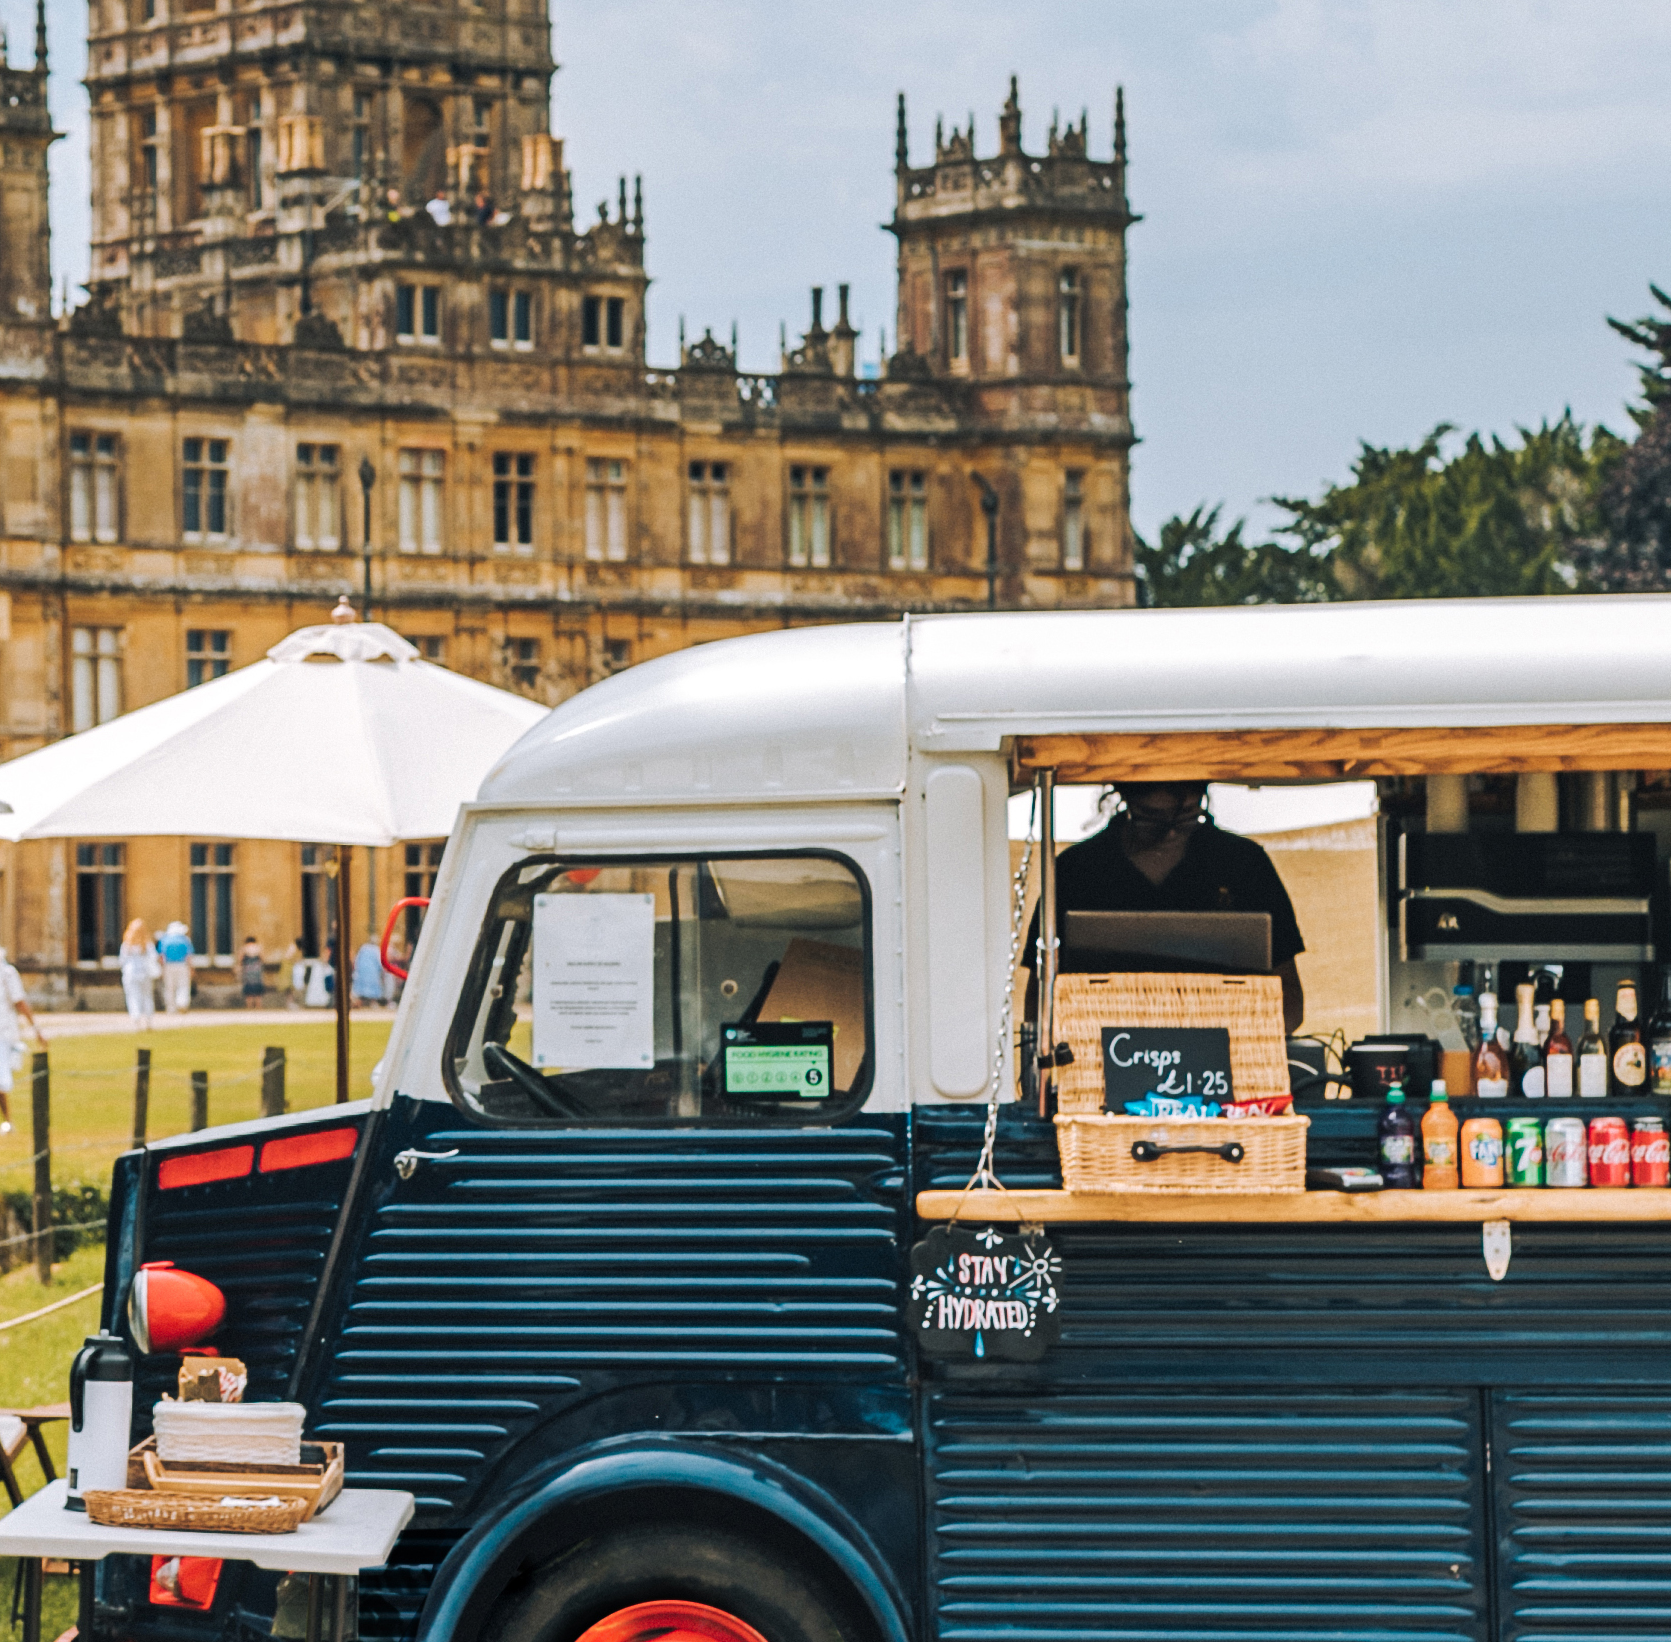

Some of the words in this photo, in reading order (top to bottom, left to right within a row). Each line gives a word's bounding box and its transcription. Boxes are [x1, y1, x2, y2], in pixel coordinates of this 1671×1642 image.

[1109, 1032, 1182, 1076] Crisps
[809, 1069, 819, 1085] 5
[958, 1252, 1008, 1286] STAY
[938, 1294, 1029, 1331] HYDRATED
